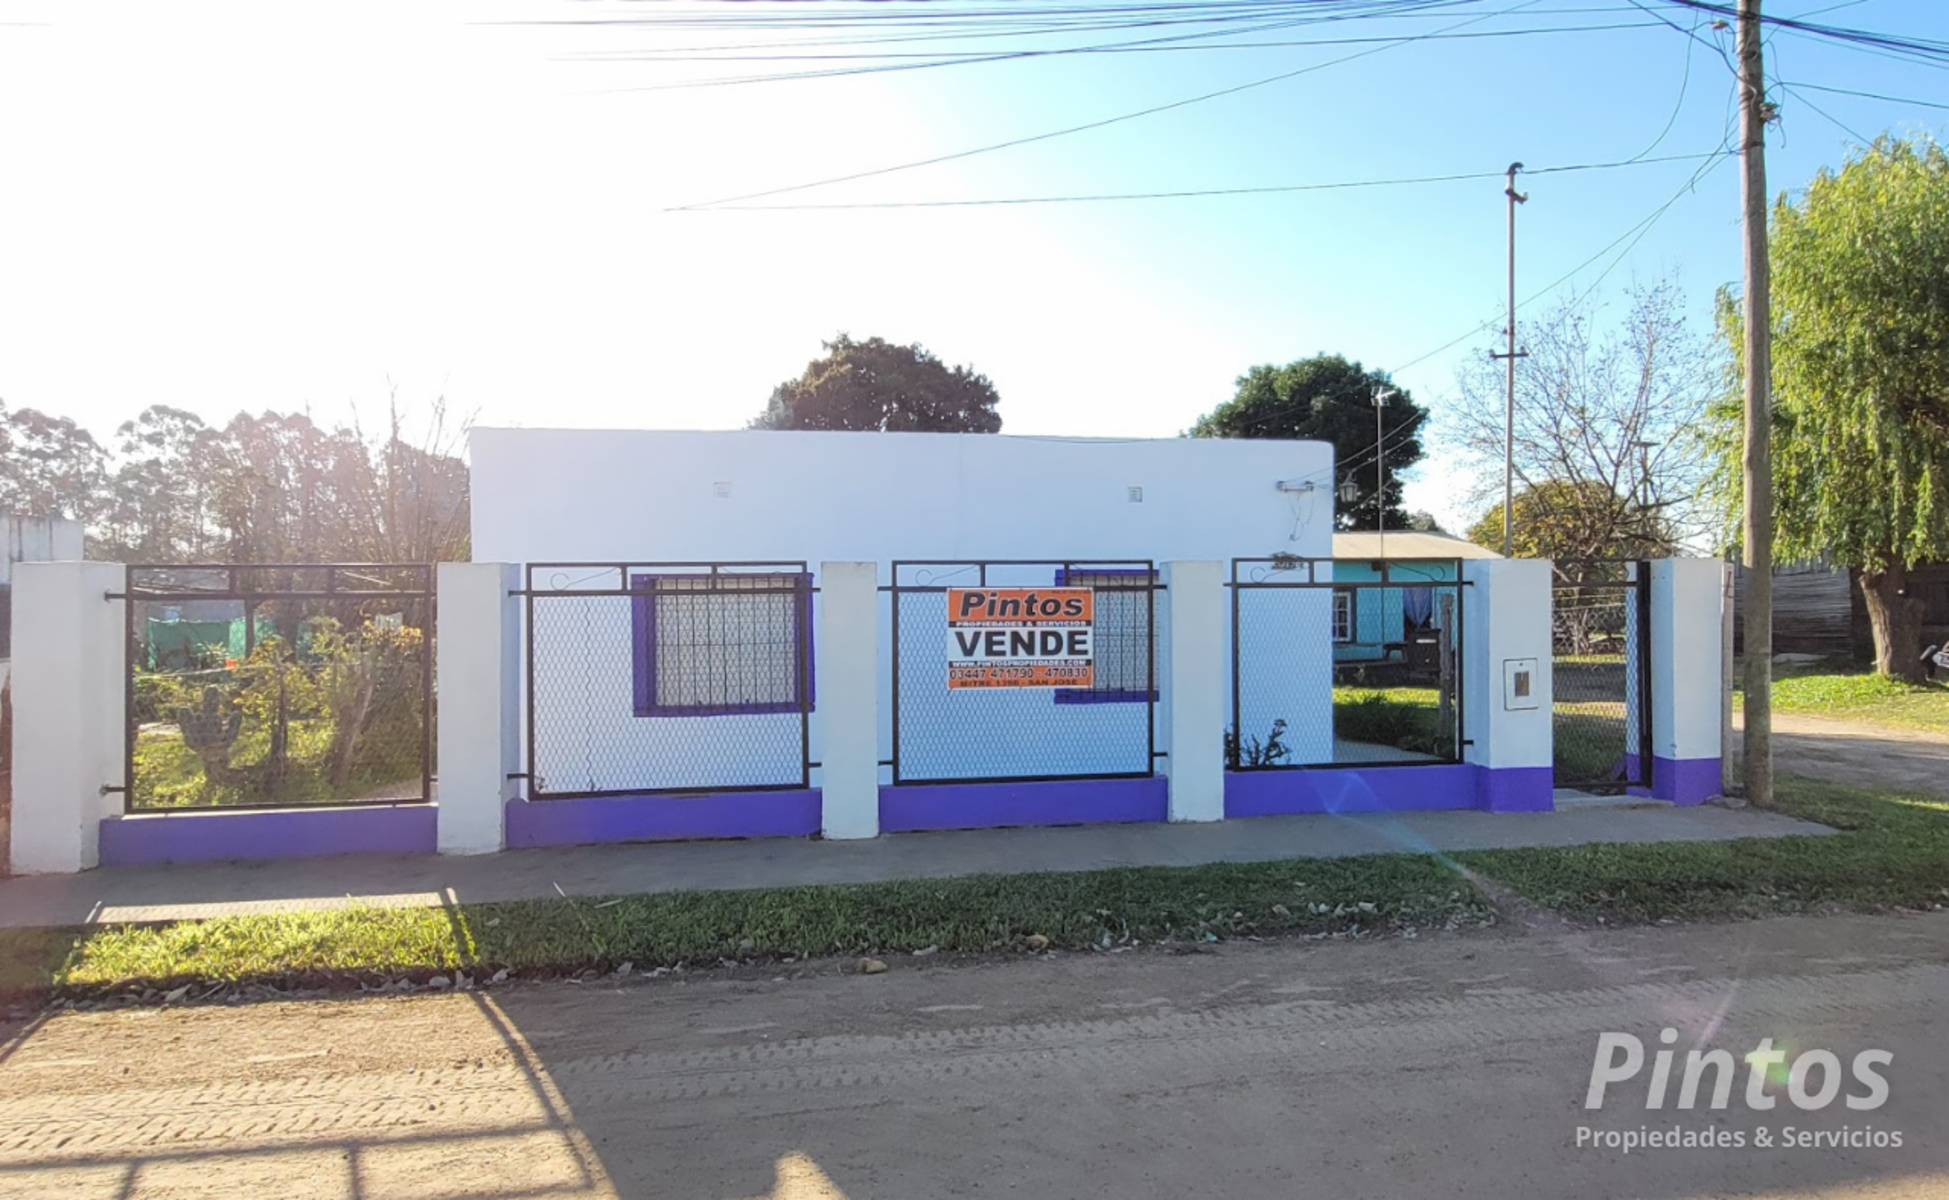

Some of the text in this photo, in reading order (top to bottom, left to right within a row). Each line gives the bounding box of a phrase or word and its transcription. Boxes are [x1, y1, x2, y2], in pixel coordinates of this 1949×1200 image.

[960, 591, 1085, 618] Pintos
[955, 630, 1089, 657] VENDE
[949, 668, 986, 679] 03447
[990, 668, 1034, 679] 471790
[1045, 667, 1088, 678] 470830
